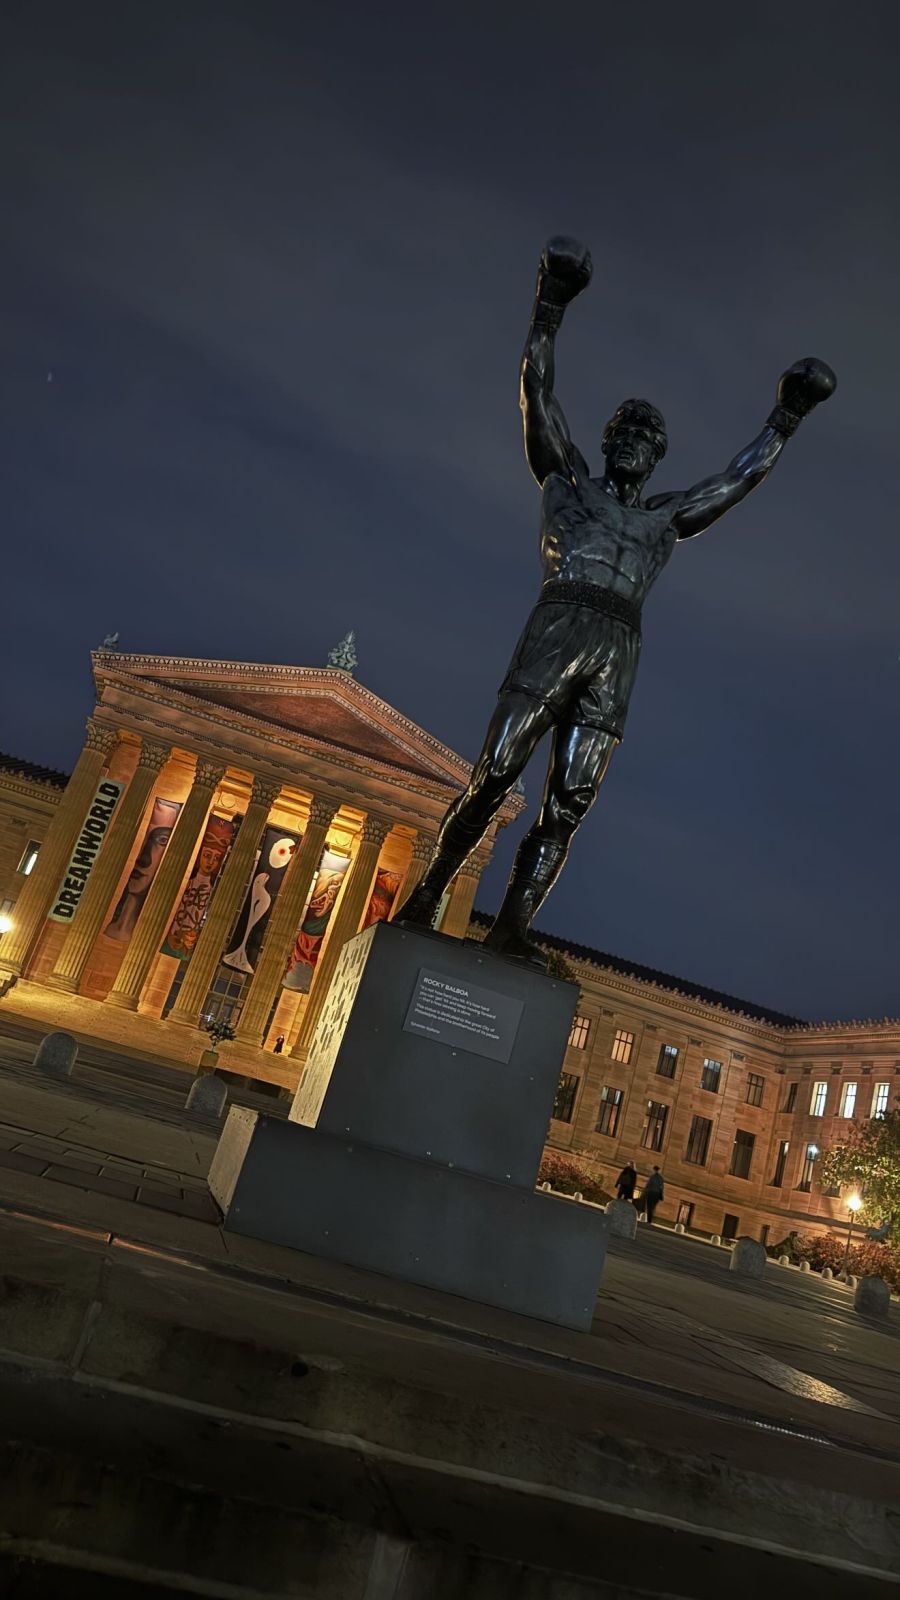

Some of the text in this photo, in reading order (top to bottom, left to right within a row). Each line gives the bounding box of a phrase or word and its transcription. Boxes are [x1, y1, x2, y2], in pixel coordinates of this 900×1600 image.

[53, 782, 120, 918] DREAMWORLD
[423, 977, 469, 997] ROCKY BALBOA
